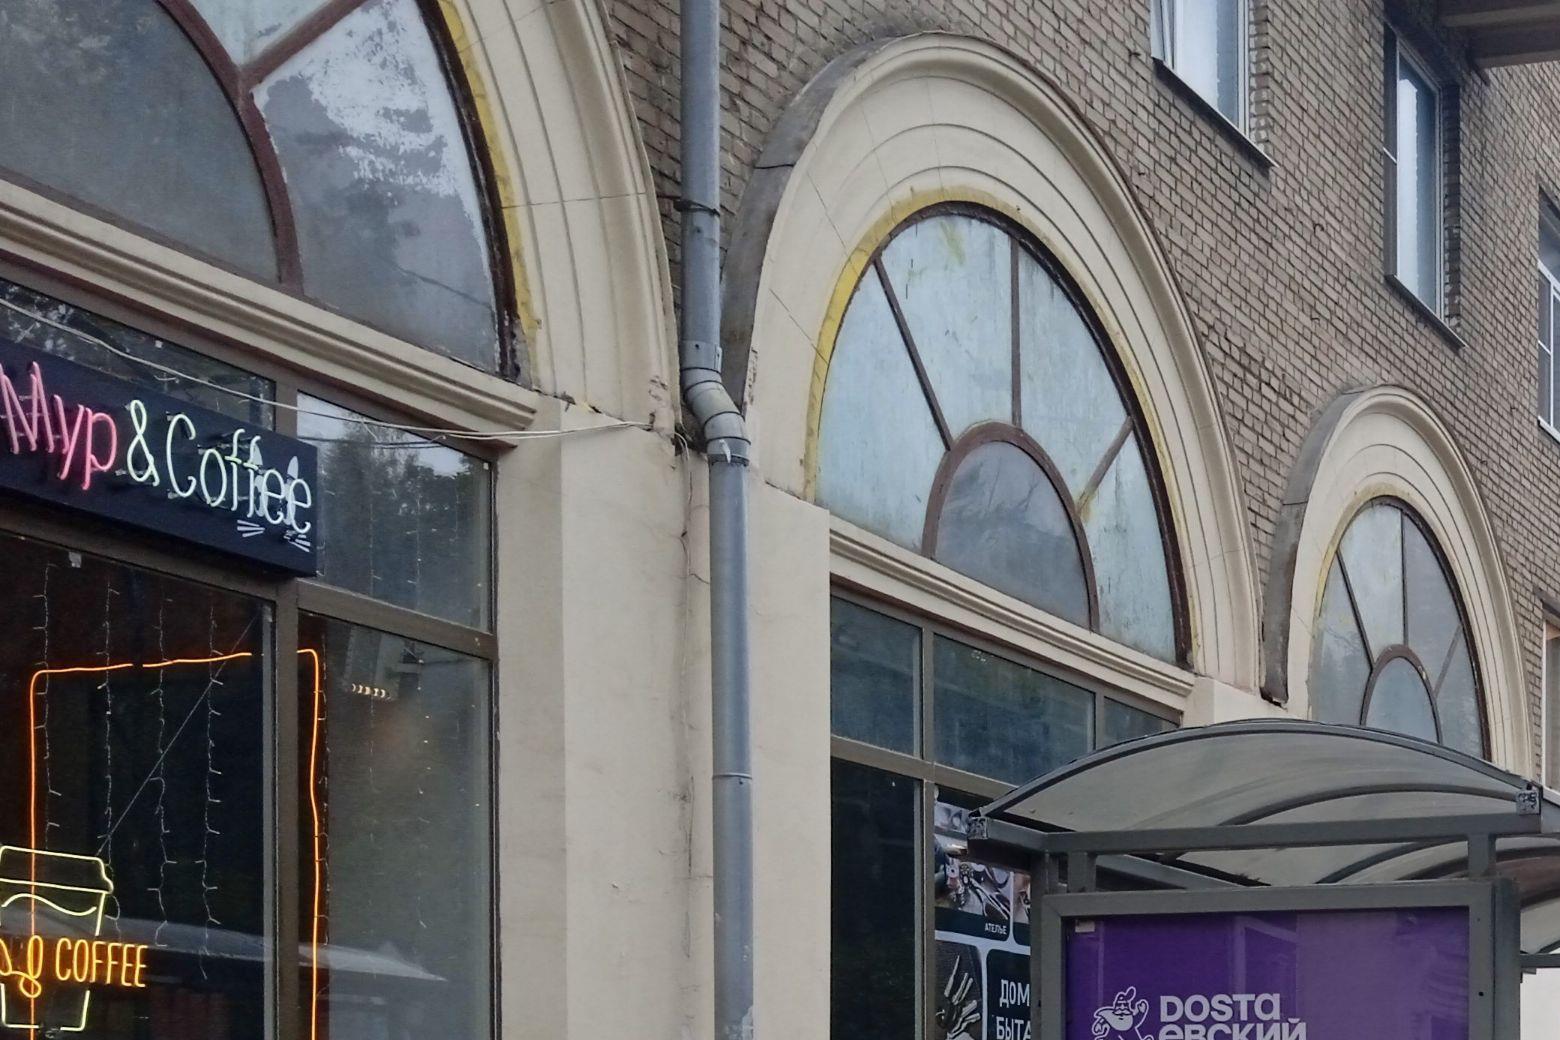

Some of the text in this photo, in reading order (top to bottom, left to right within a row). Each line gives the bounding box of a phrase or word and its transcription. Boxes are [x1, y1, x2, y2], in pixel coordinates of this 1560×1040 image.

[984, 923, 1008, 935] АТЕЛЬЕ
[55, 938, 148, 987] COFFEE
[1000, 979, 1030, 1008] ДОМ
